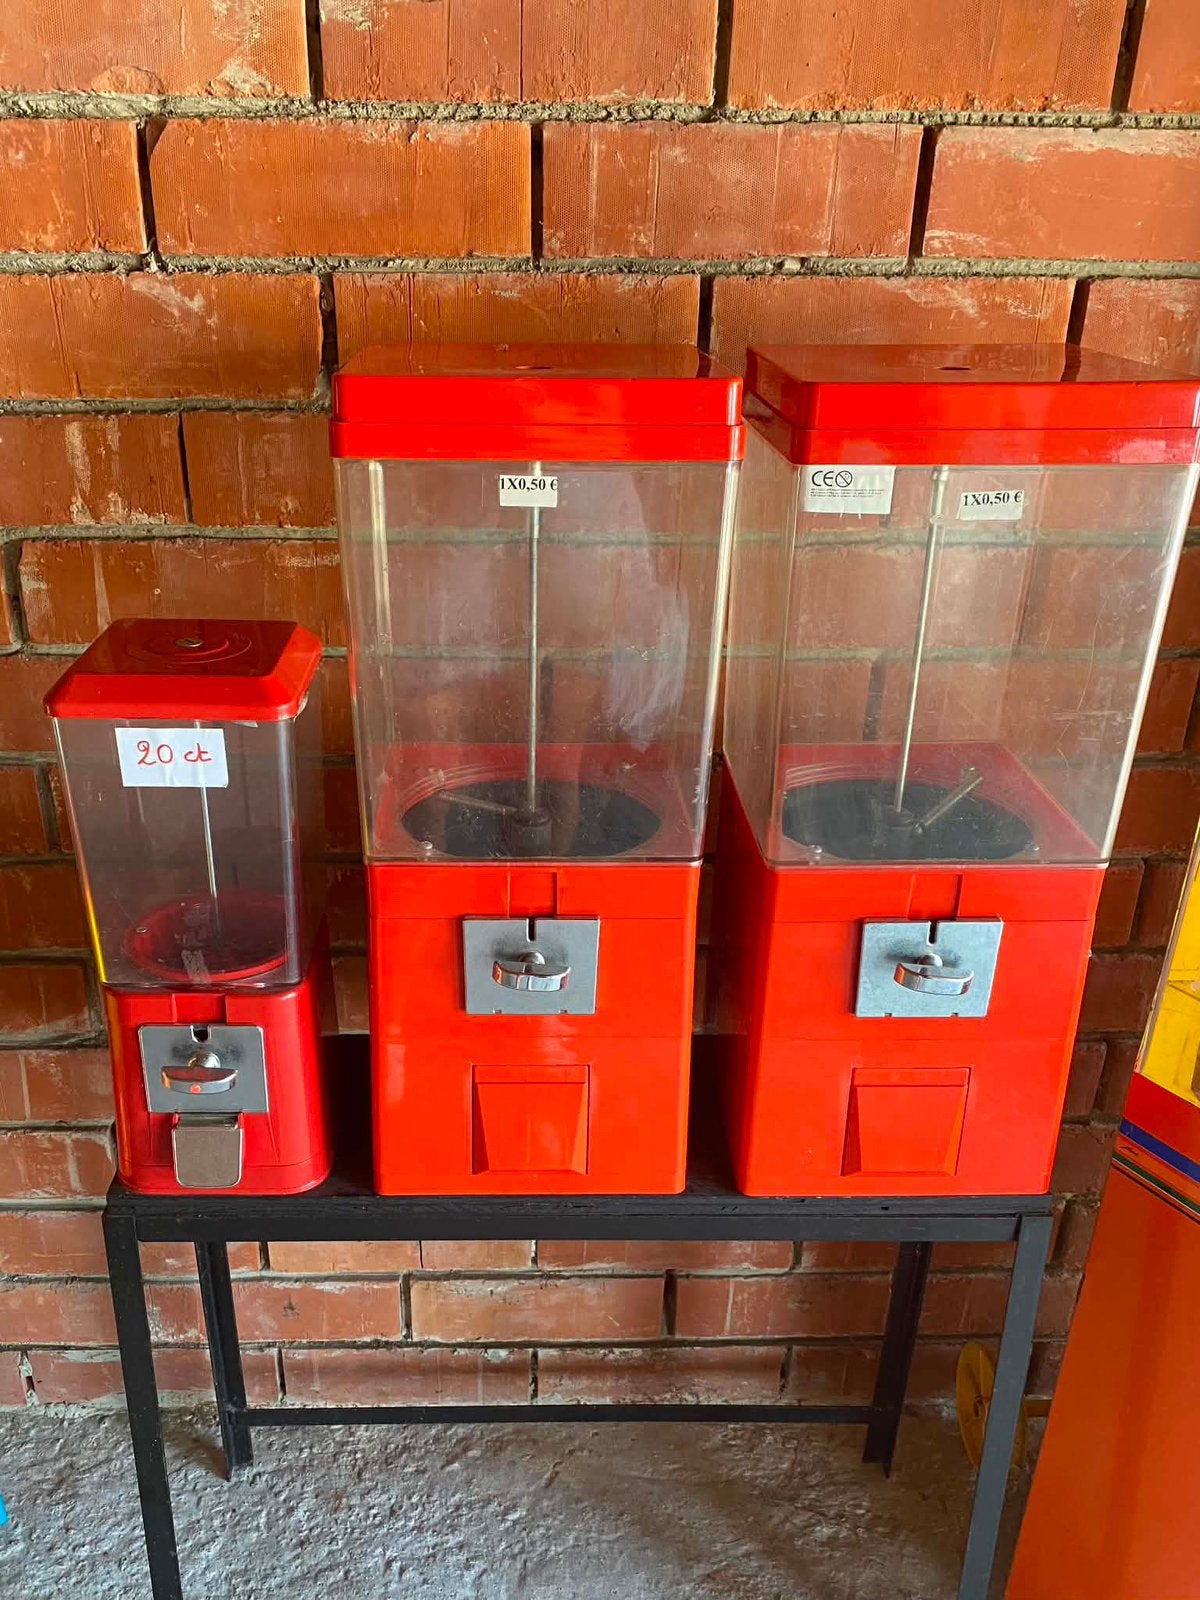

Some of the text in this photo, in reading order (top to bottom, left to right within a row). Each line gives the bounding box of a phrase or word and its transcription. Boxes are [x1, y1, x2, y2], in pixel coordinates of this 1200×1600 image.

[500, 477, 559, 492] 1X0,50 €
[963, 490, 1023, 507] 1X0,50 €
[137, 740, 213, 766] 20 ct
